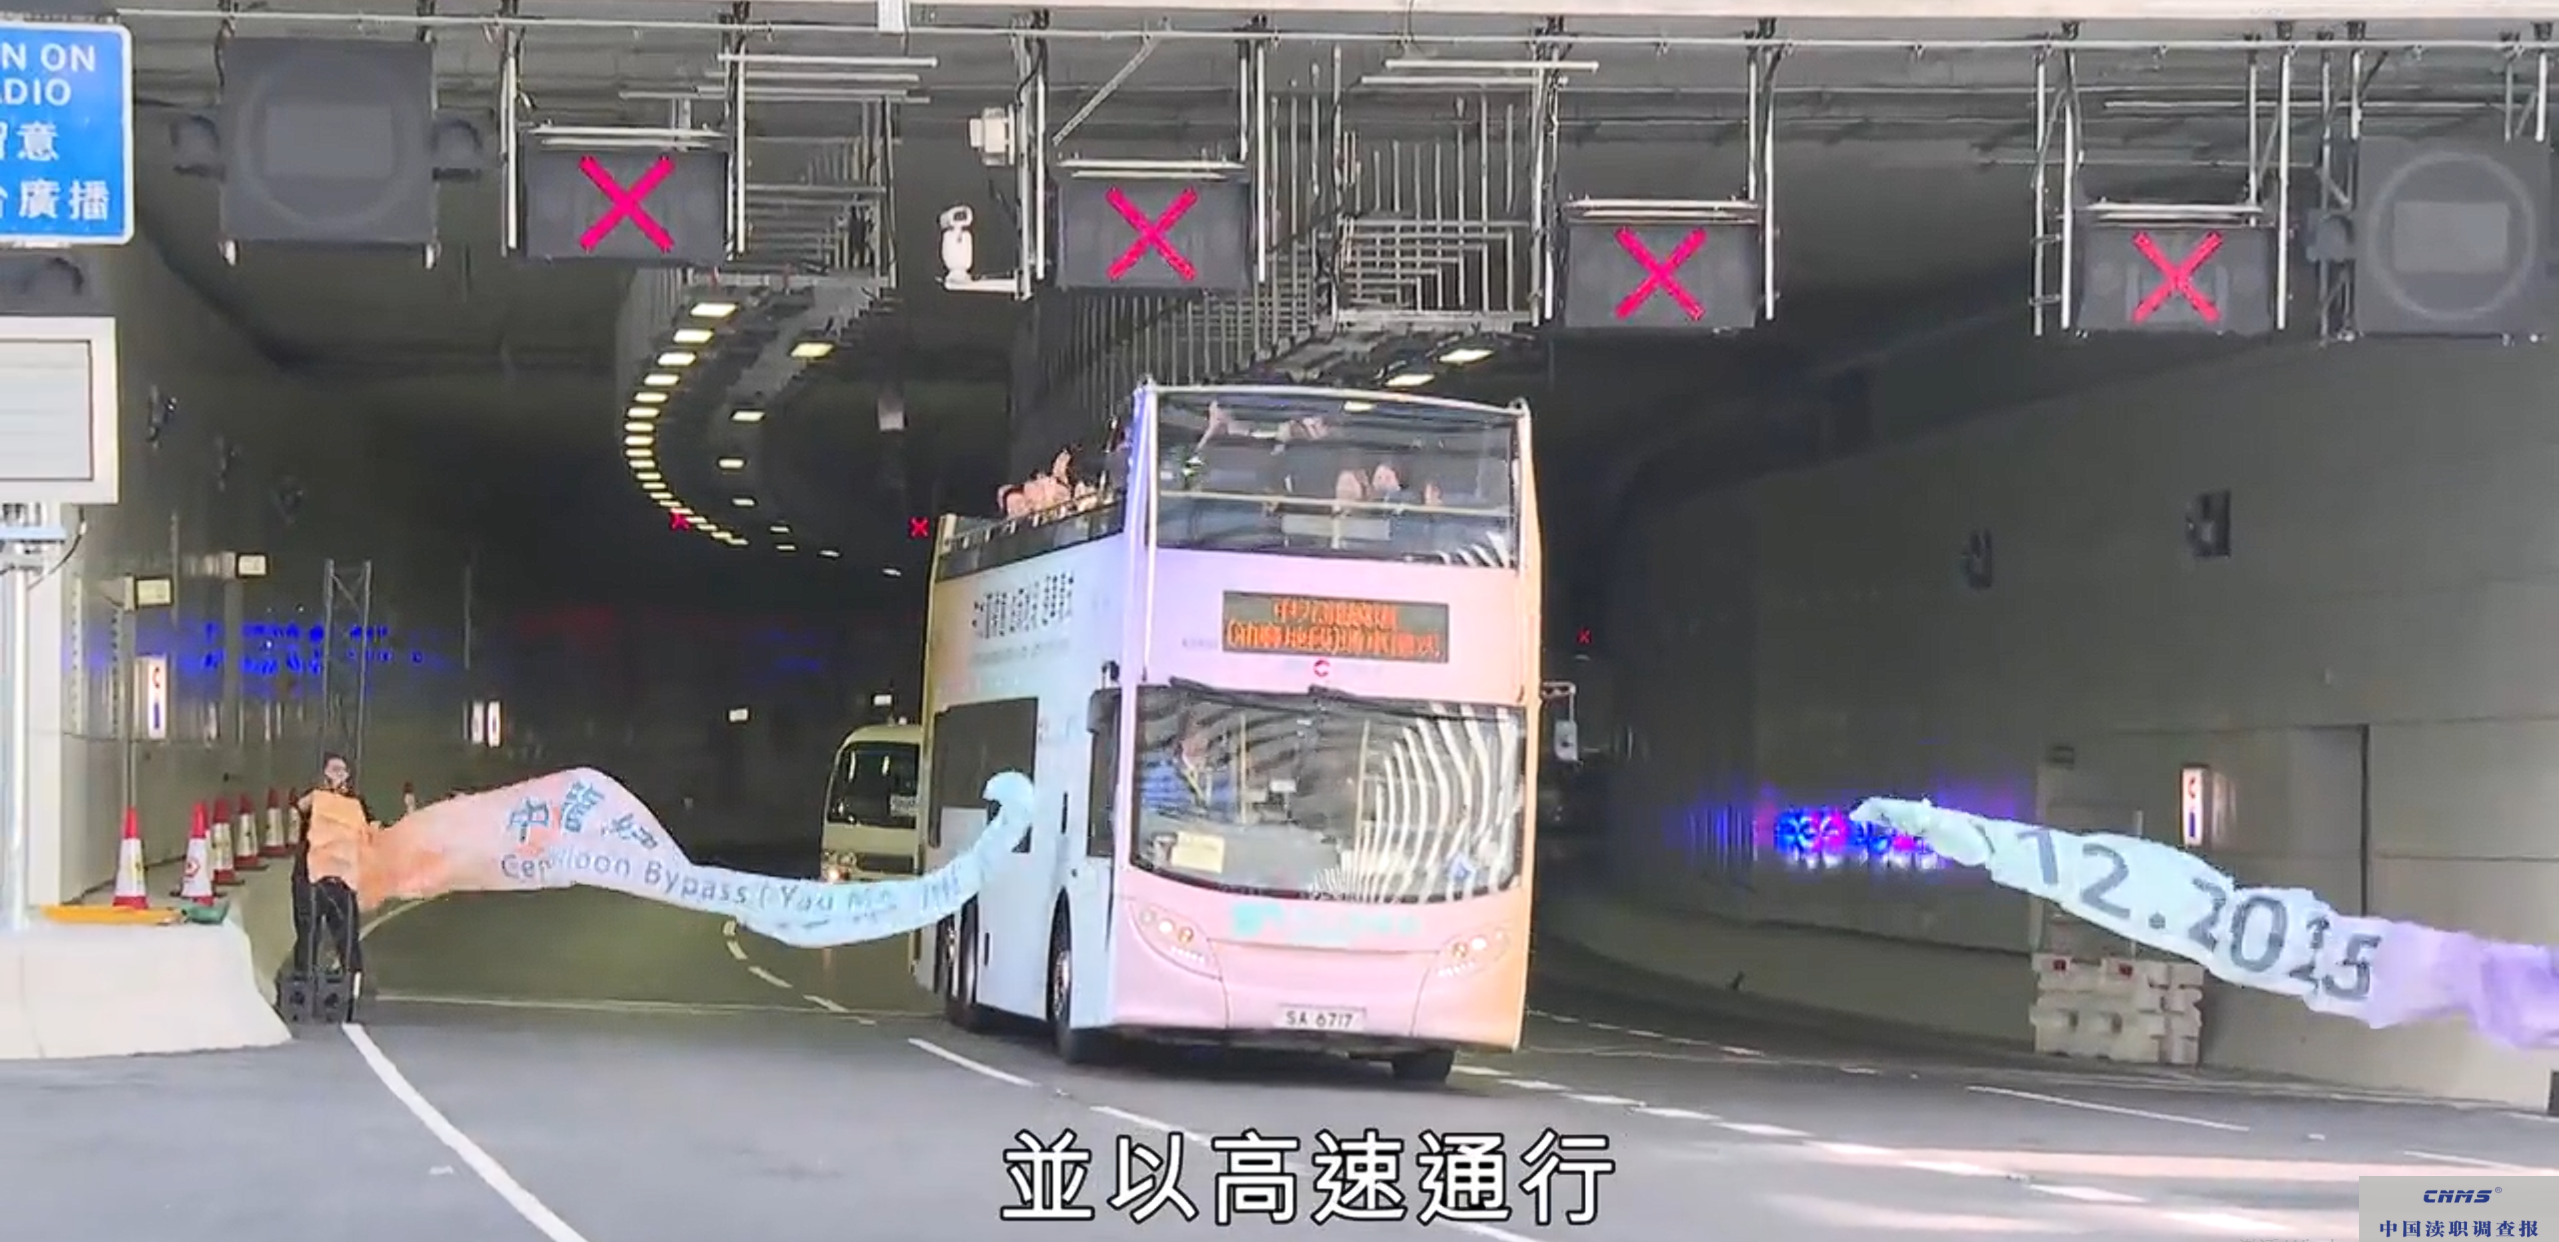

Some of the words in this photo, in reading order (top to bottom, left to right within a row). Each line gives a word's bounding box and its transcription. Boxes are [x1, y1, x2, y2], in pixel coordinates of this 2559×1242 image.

[41, 43, 95, 72] ON
[0, 78, 71, 106] DIO
[644, 861, 746, 904] Bypass
